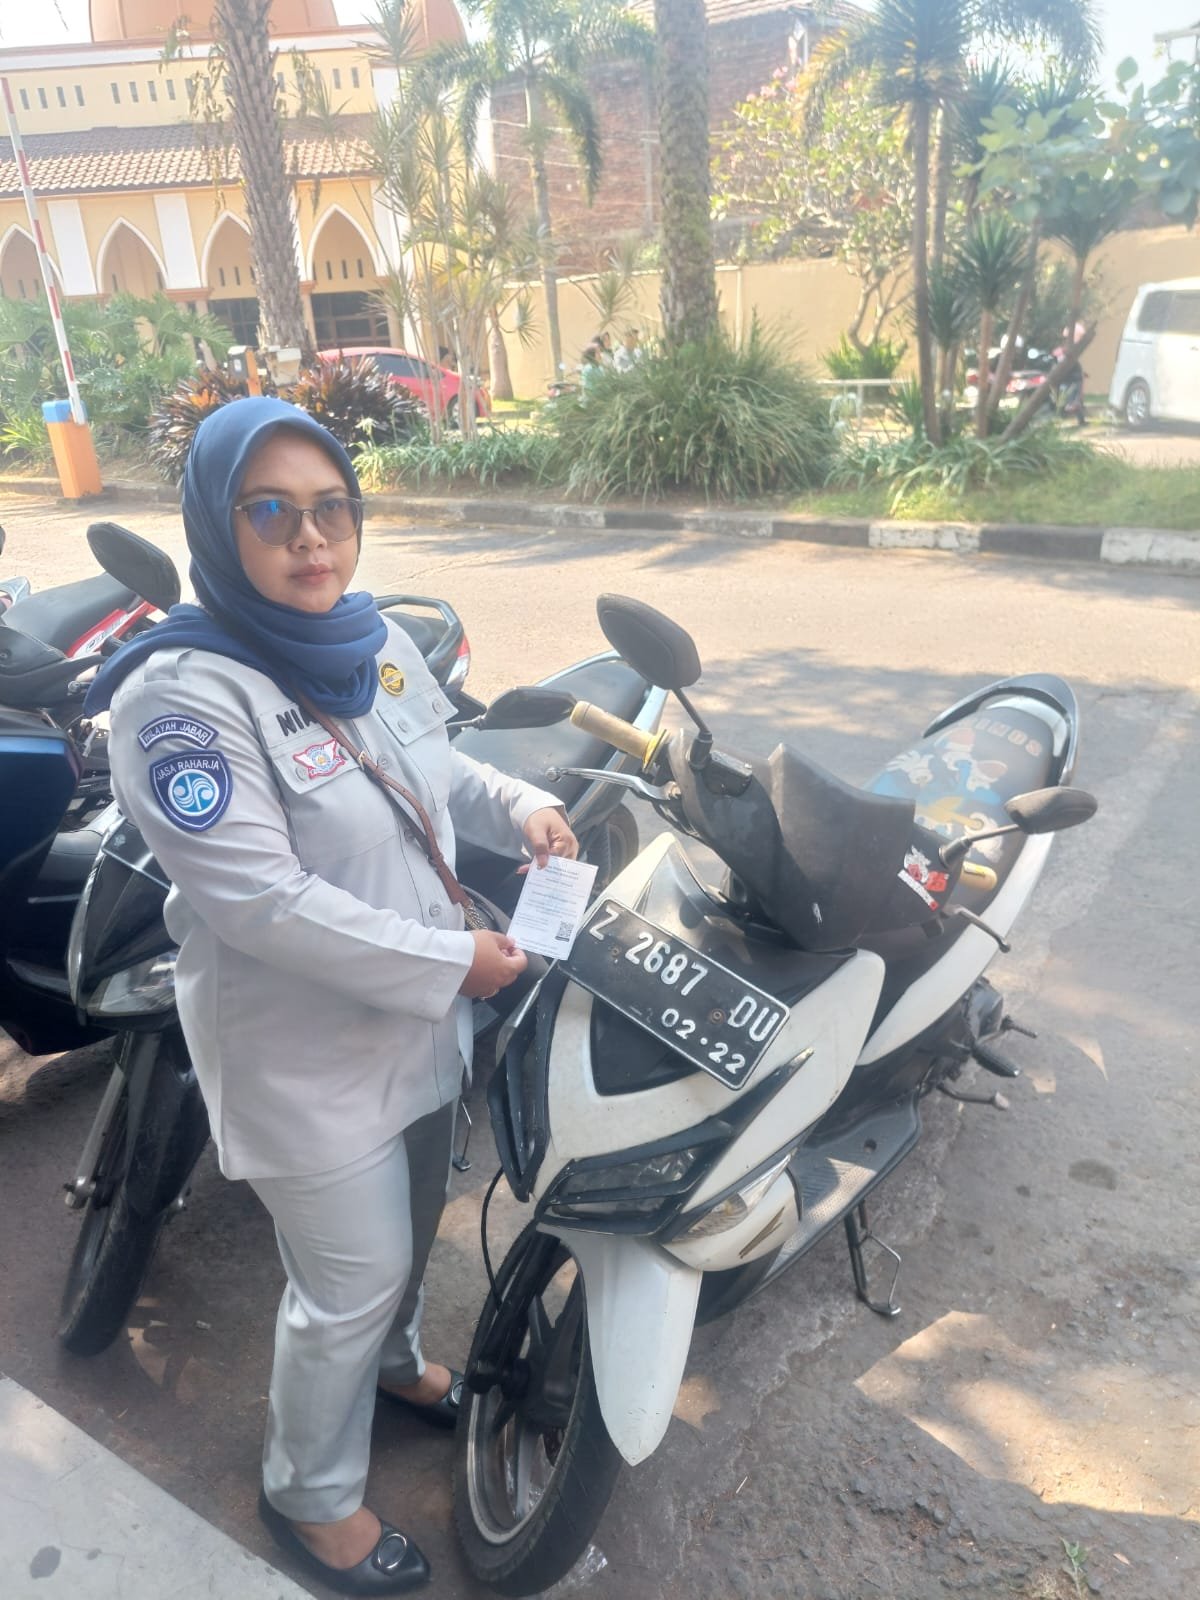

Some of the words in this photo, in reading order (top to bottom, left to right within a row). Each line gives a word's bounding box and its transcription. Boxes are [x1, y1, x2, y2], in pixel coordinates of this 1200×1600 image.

[143, 721, 177, 743] WILAYAH
[179, 722, 209, 741] JABAR
[157, 764, 177, 781] JASA
[177, 759, 220, 771] RAHARJA
[589, 906, 620, 941] Z
[624, 931, 709, 997] 2687
[727, 995, 780, 1042] DU
